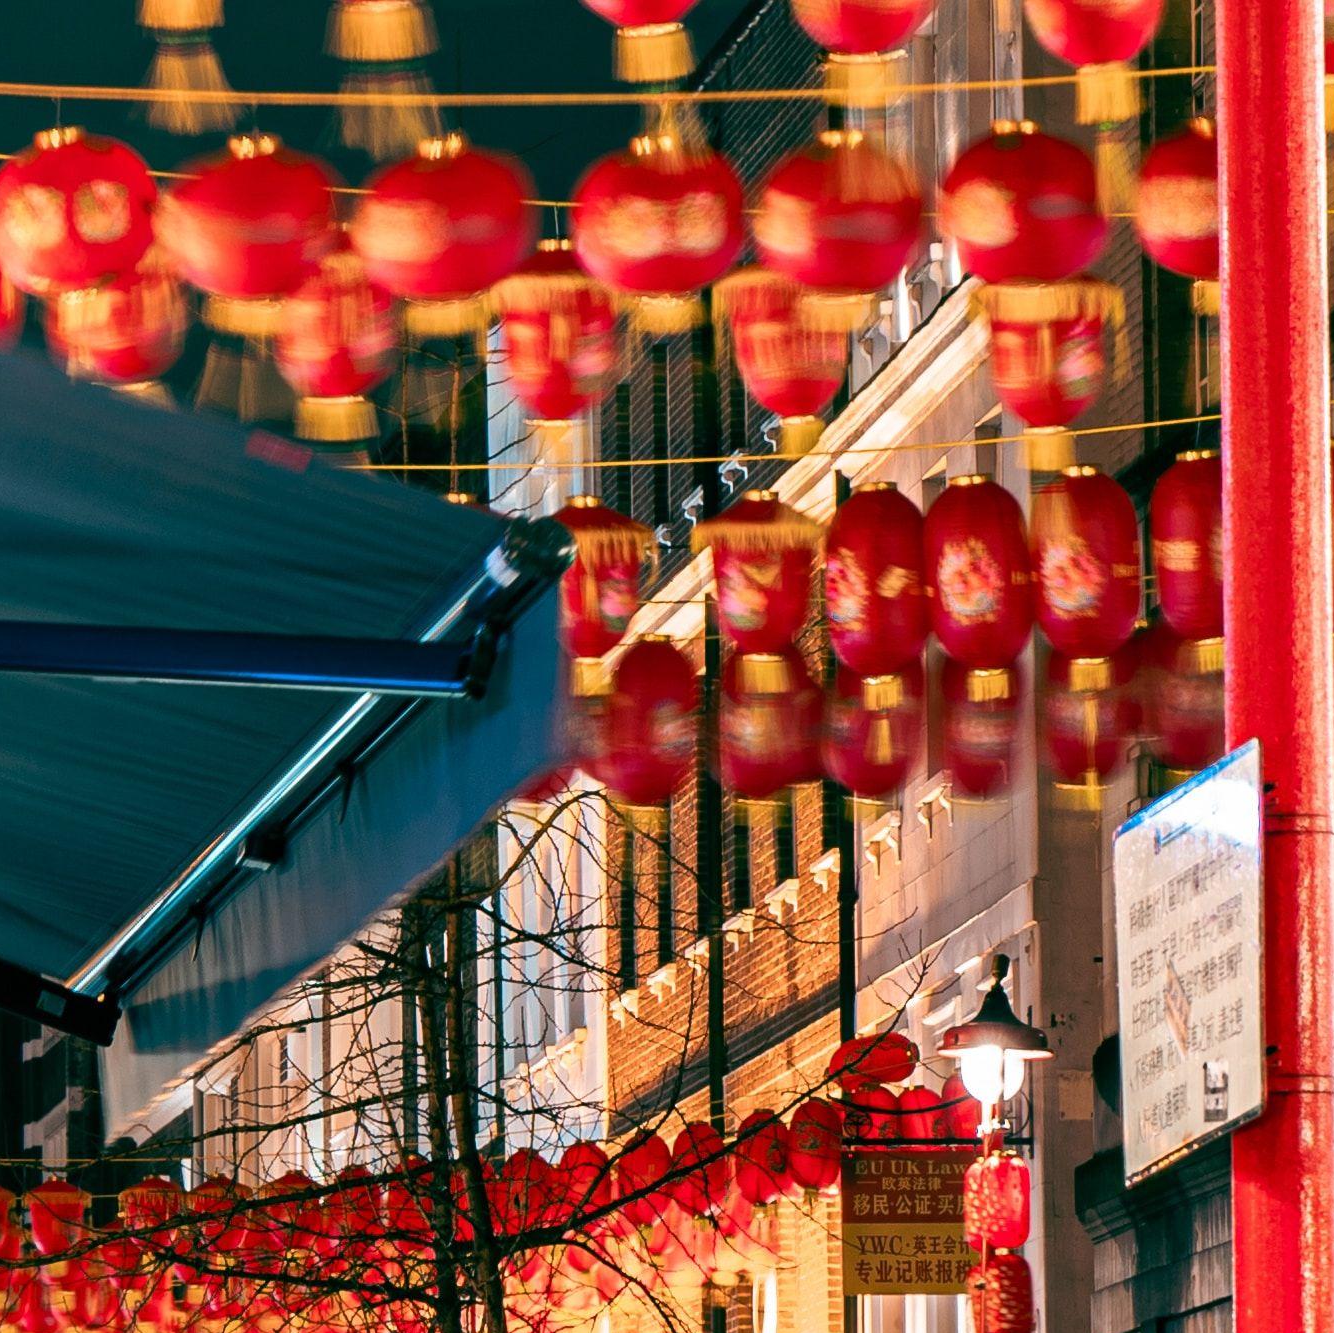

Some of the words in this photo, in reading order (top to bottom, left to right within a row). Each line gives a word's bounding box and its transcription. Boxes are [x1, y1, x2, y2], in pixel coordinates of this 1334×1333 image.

[854, 1160, 884, 1175] EU
[891, 1160, 920, 1175] UK
[927, 1160, 966, 1175] Law
[881, 1177, 942, 1191] 欧英法律
